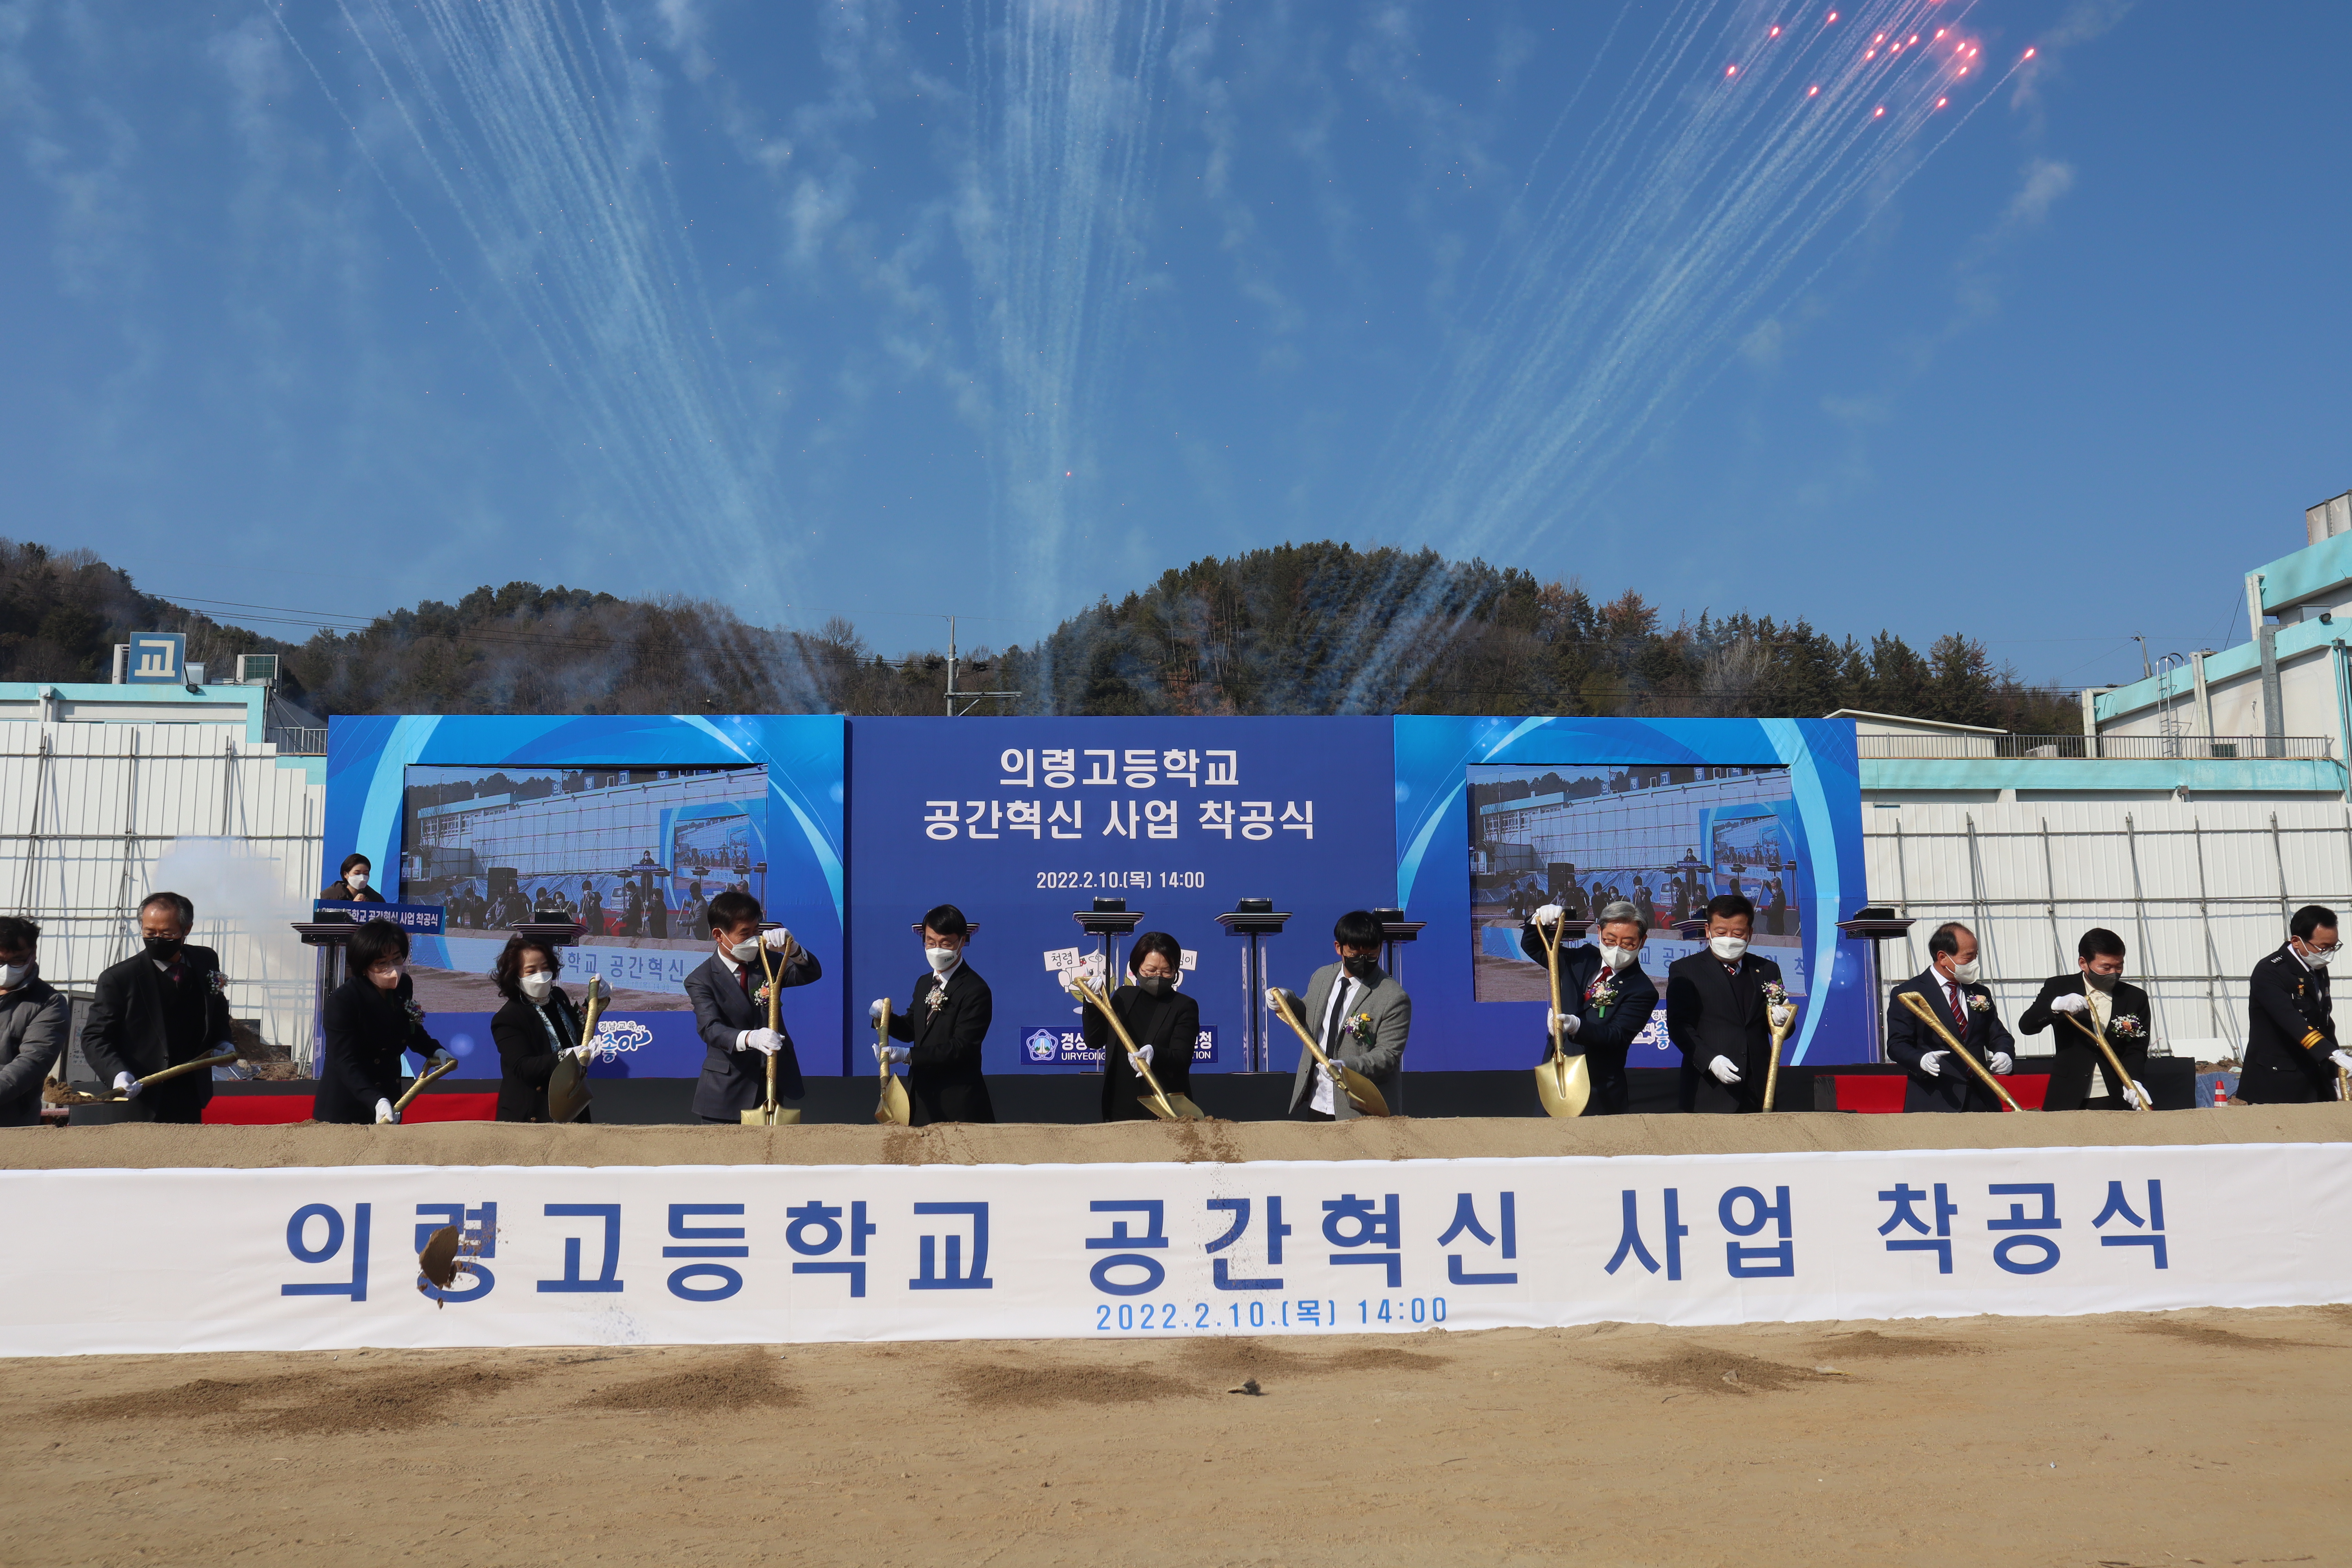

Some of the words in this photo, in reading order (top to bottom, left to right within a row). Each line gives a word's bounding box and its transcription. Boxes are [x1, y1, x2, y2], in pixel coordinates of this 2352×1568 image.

[135, 640, 175, 676] 교
[1000, 749, 1238, 788] 의령고등학교
[924, 800, 1082, 840] 공간혁신
[1102, 800, 1177, 839] 사업
[1199, 800, 1313, 840] 착공식
[1037, 871, 1151, 889] 2022.2.10.(목)
[1160, 872, 1204, 888] 14:00
[400, 912, 414, 925] 사업
[416, 912, 438, 926] 착공식
[610, 955, 684, 983] 공간혁신
[1051, 951, 1073, 967] 청렴
[599, 1022, 635, 1031] 경남교육
[281, 1200, 993, 1303] 의령고등학교
[1085, 1191, 1518, 1296] 공간혁신
[1604, 1185, 1794, 1281] 사업
[1877, 1179, 2169, 1275] 착공식
[1096, 1299, 1335, 1330] 2022.2.10.(목)
[1358, 1297, 1446, 1324] 14:00
